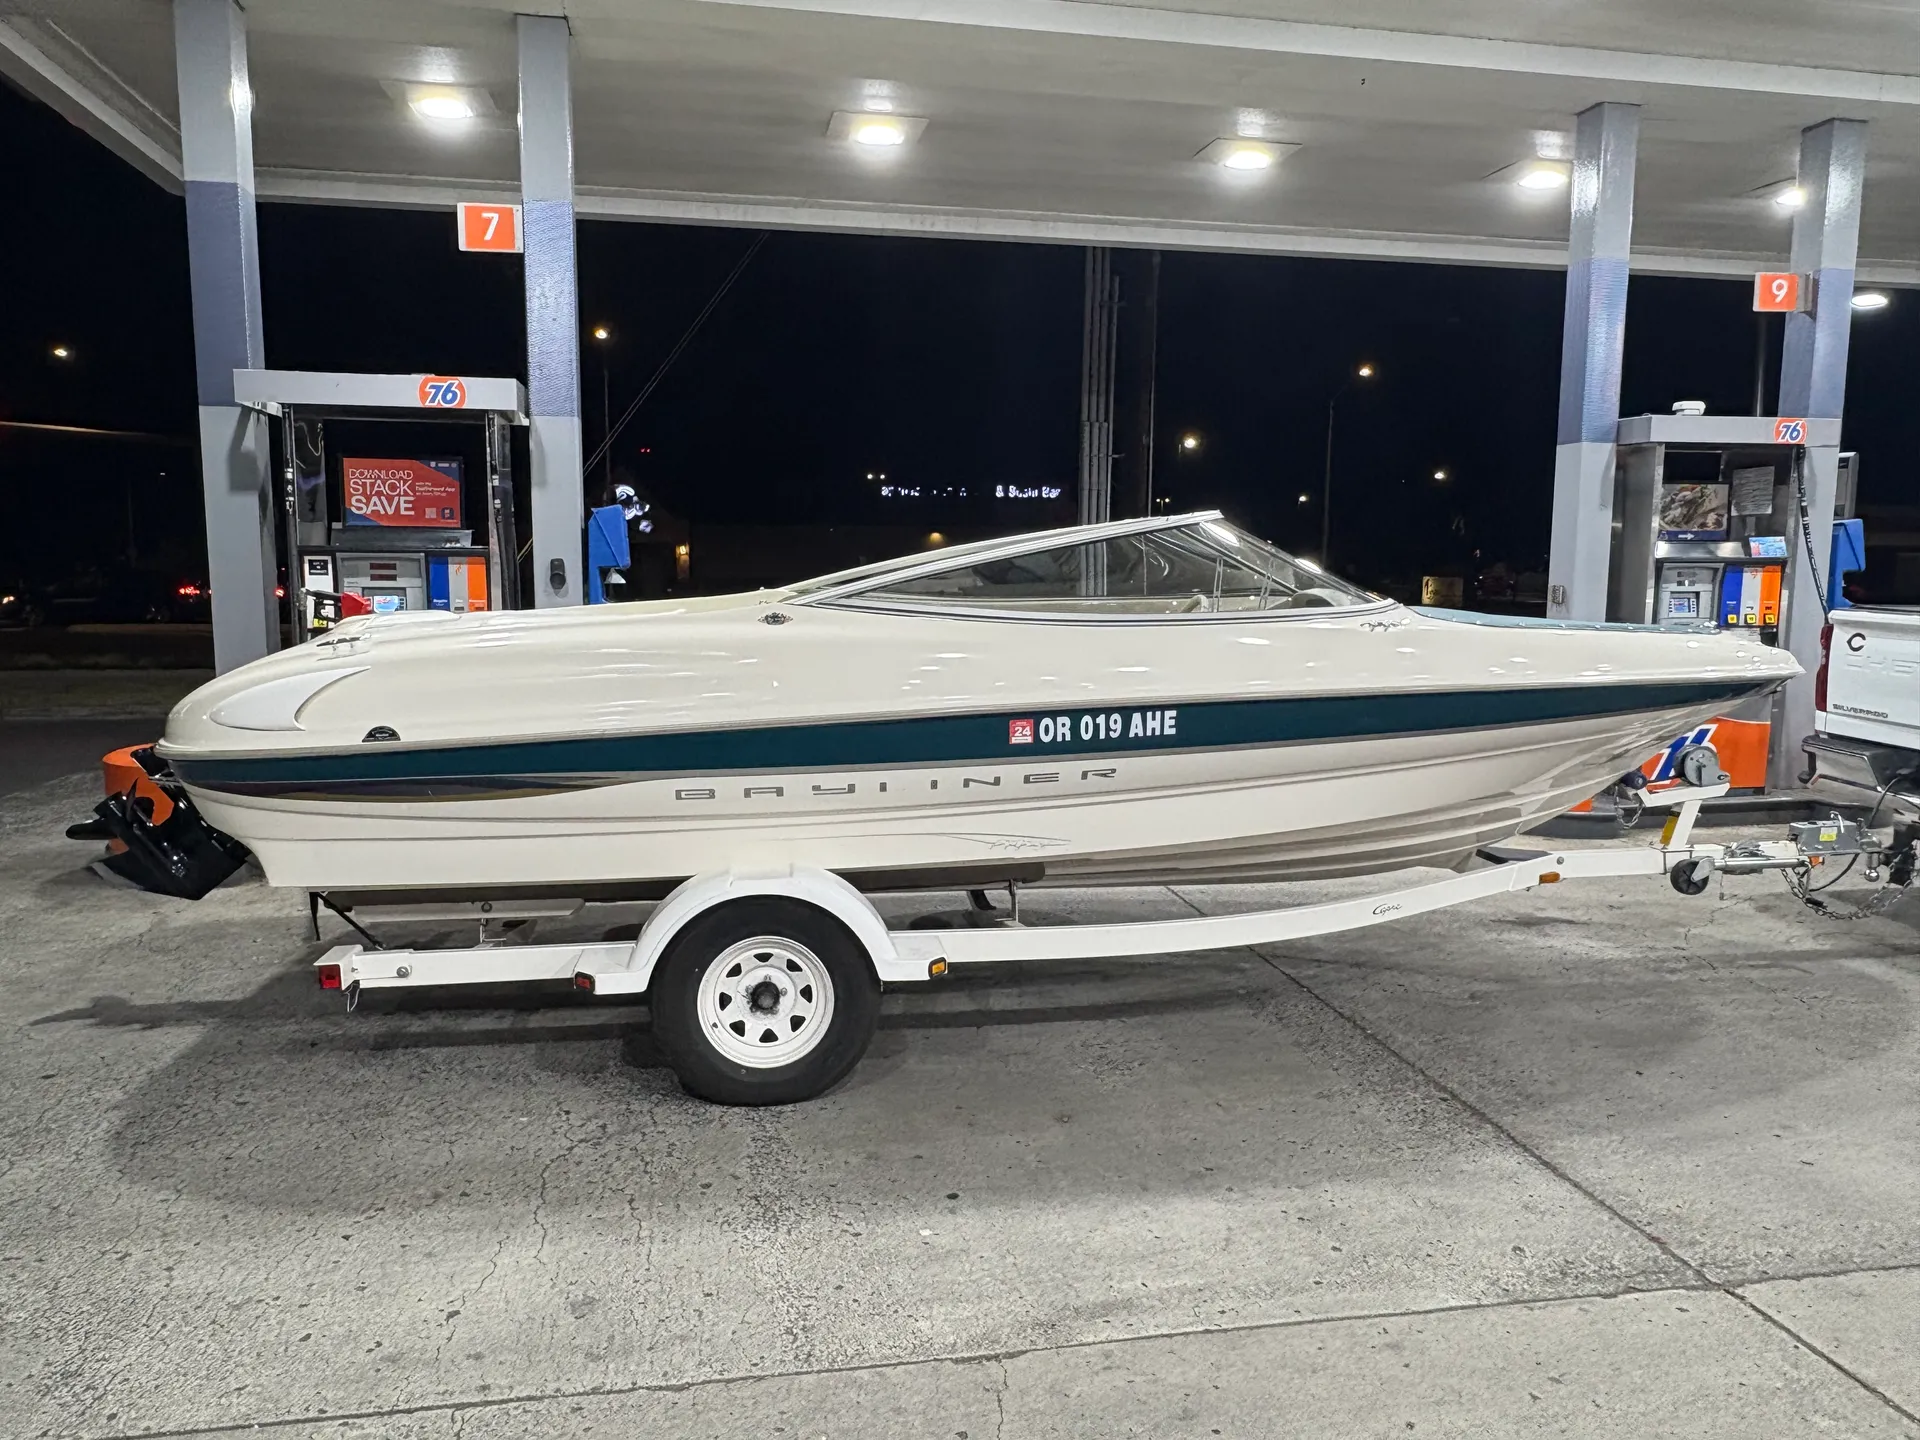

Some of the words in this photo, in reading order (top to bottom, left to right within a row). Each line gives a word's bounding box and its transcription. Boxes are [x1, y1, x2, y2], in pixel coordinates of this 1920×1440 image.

[481, 212, 499, 241] 7
[1771, 278, 1789, 303] 9
[424, 380, 461, 407] 76
[1779, 420, 1804, 443] 76
[348, 468, 414, 480] DOWNLOAD
[349, 480, 414, 496] STACK
[350, 495, 416, 515] SAVE
[1014, 726, 1032, 737] 24
[1039, 716, 1071, 743] OR
[1080, 712, 1123, 741] 019
[1128, 710, 1178, 738] AHE
